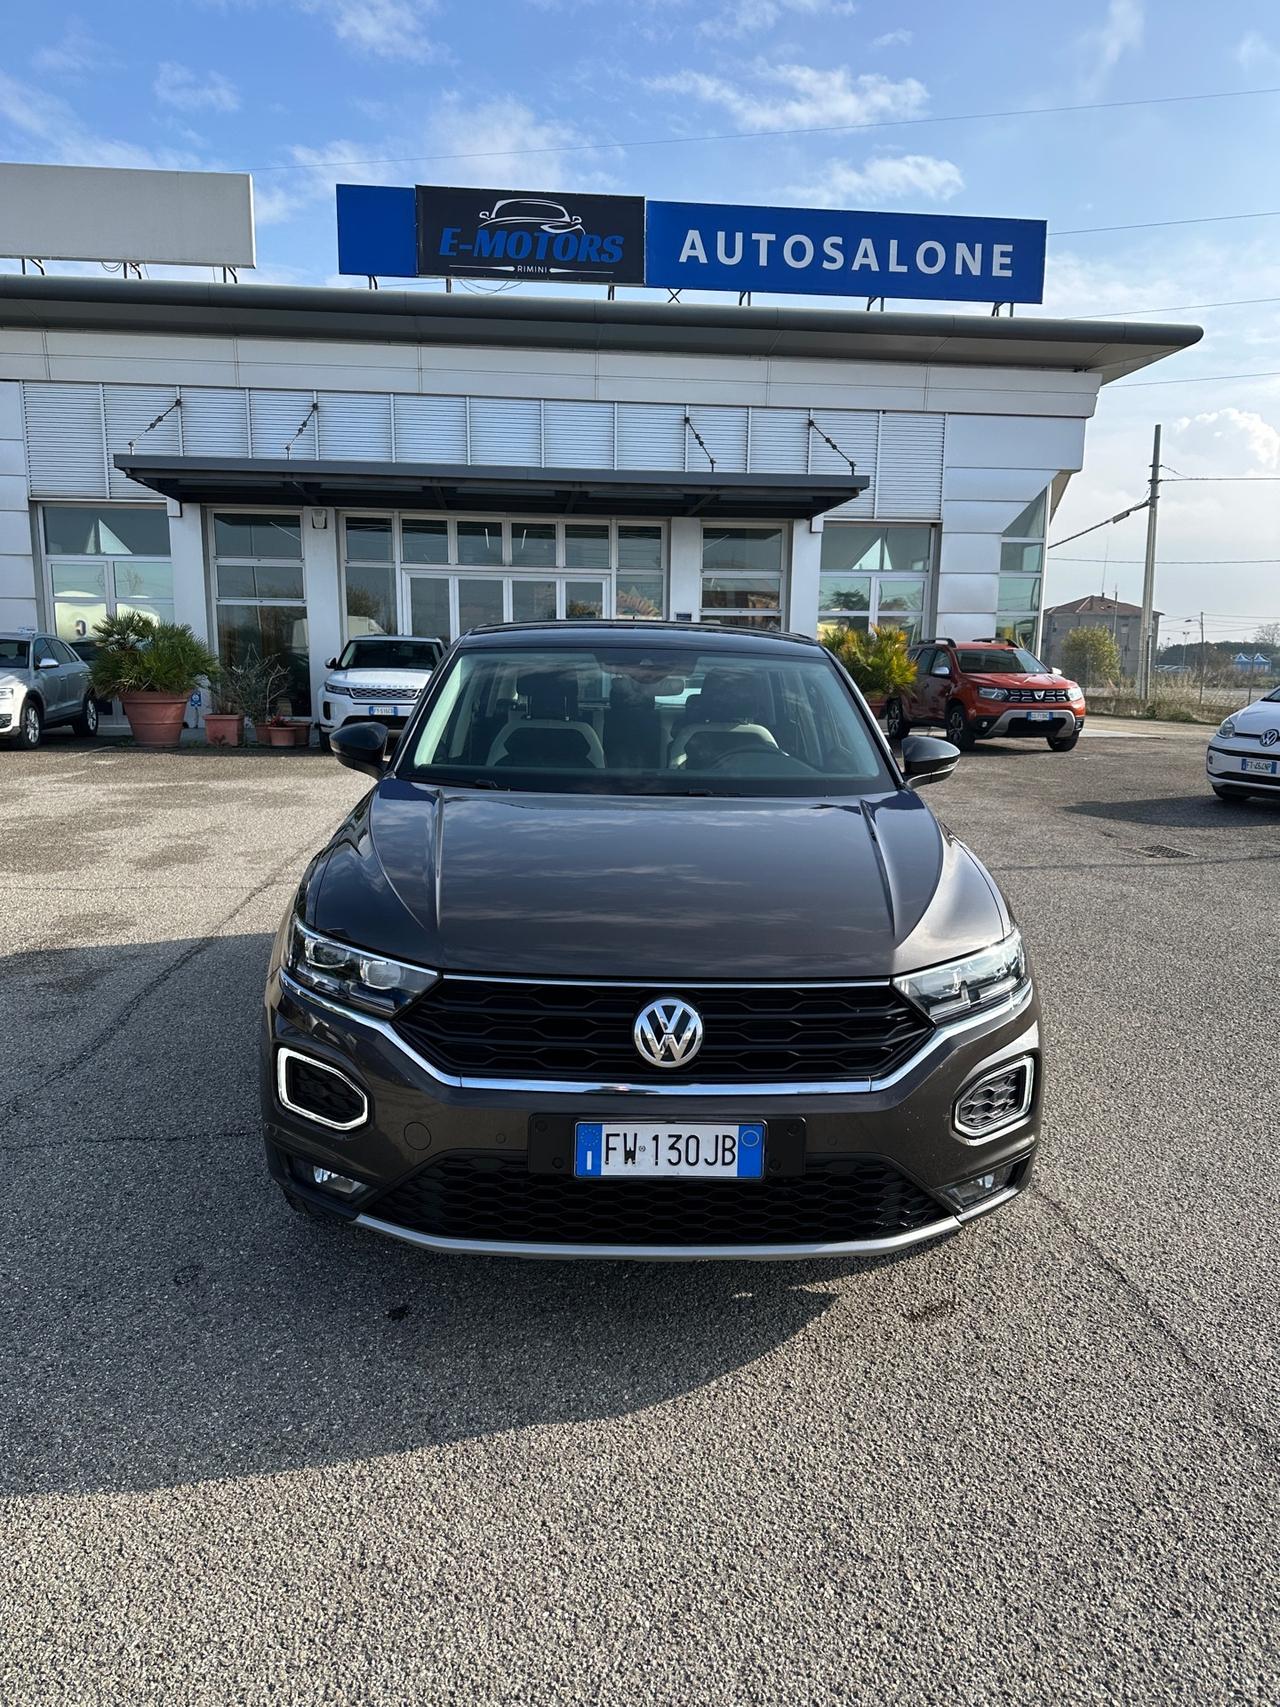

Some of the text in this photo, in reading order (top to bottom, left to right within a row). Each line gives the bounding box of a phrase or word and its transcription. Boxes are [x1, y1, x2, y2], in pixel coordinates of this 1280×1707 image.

[439, 226, 625, 264] E-MOTORS
[679, 229, 1014, 278] AUTOSALONE
[517, 264, 548, 274] RIMINI
[604, 1132, 737, 1167] FW 130JB
